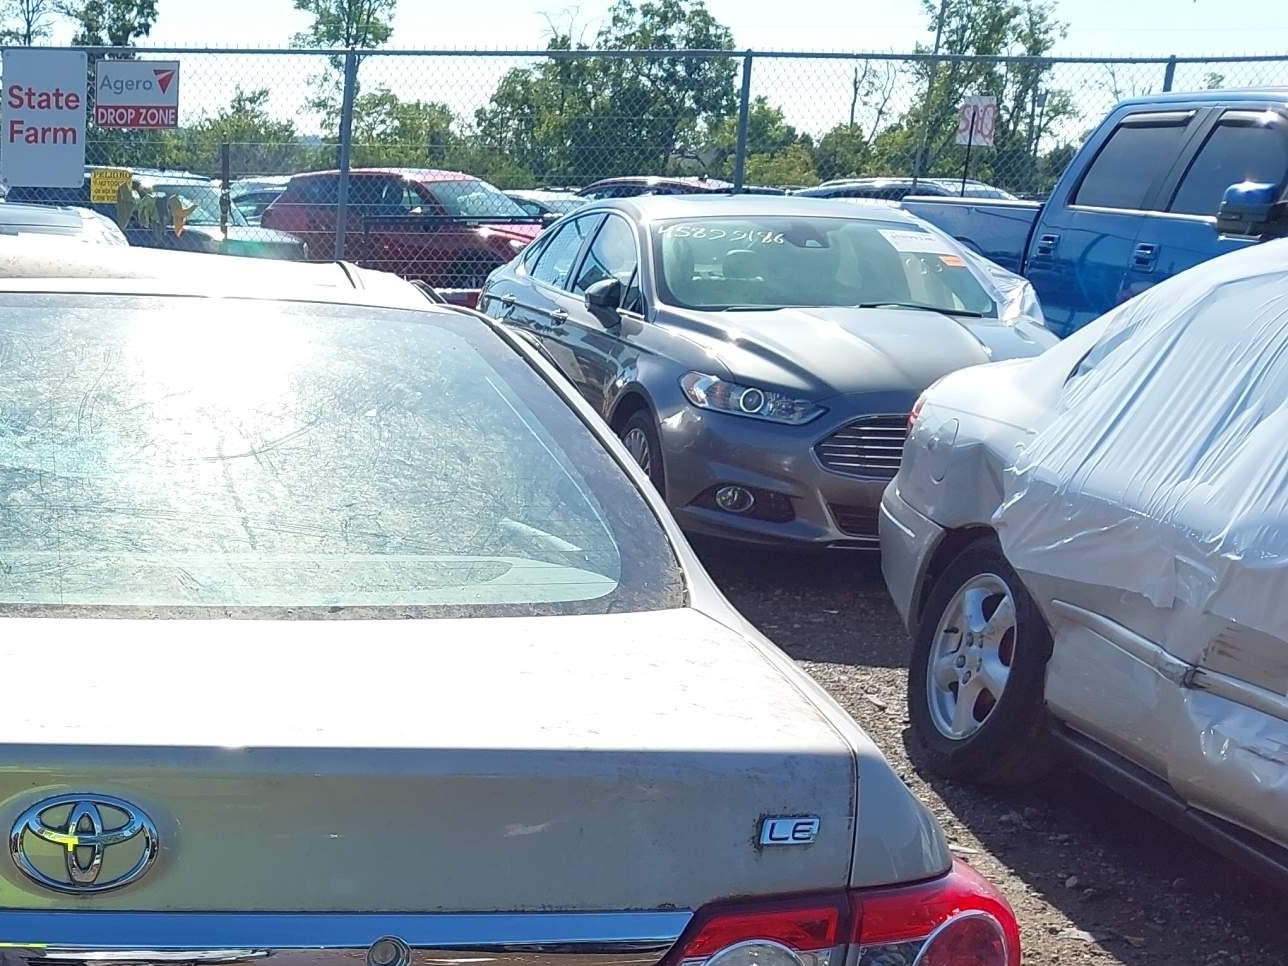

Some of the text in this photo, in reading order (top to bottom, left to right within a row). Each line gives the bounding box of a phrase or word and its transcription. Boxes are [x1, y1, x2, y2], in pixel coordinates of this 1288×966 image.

[99, 75, 153, 95] Agero
[8, 85, 80, 110] State
[98, 108, 176, 125] DROP ZONE
[9, 120, 77, 145] Farm
[768, 821, 815, 841] LE
